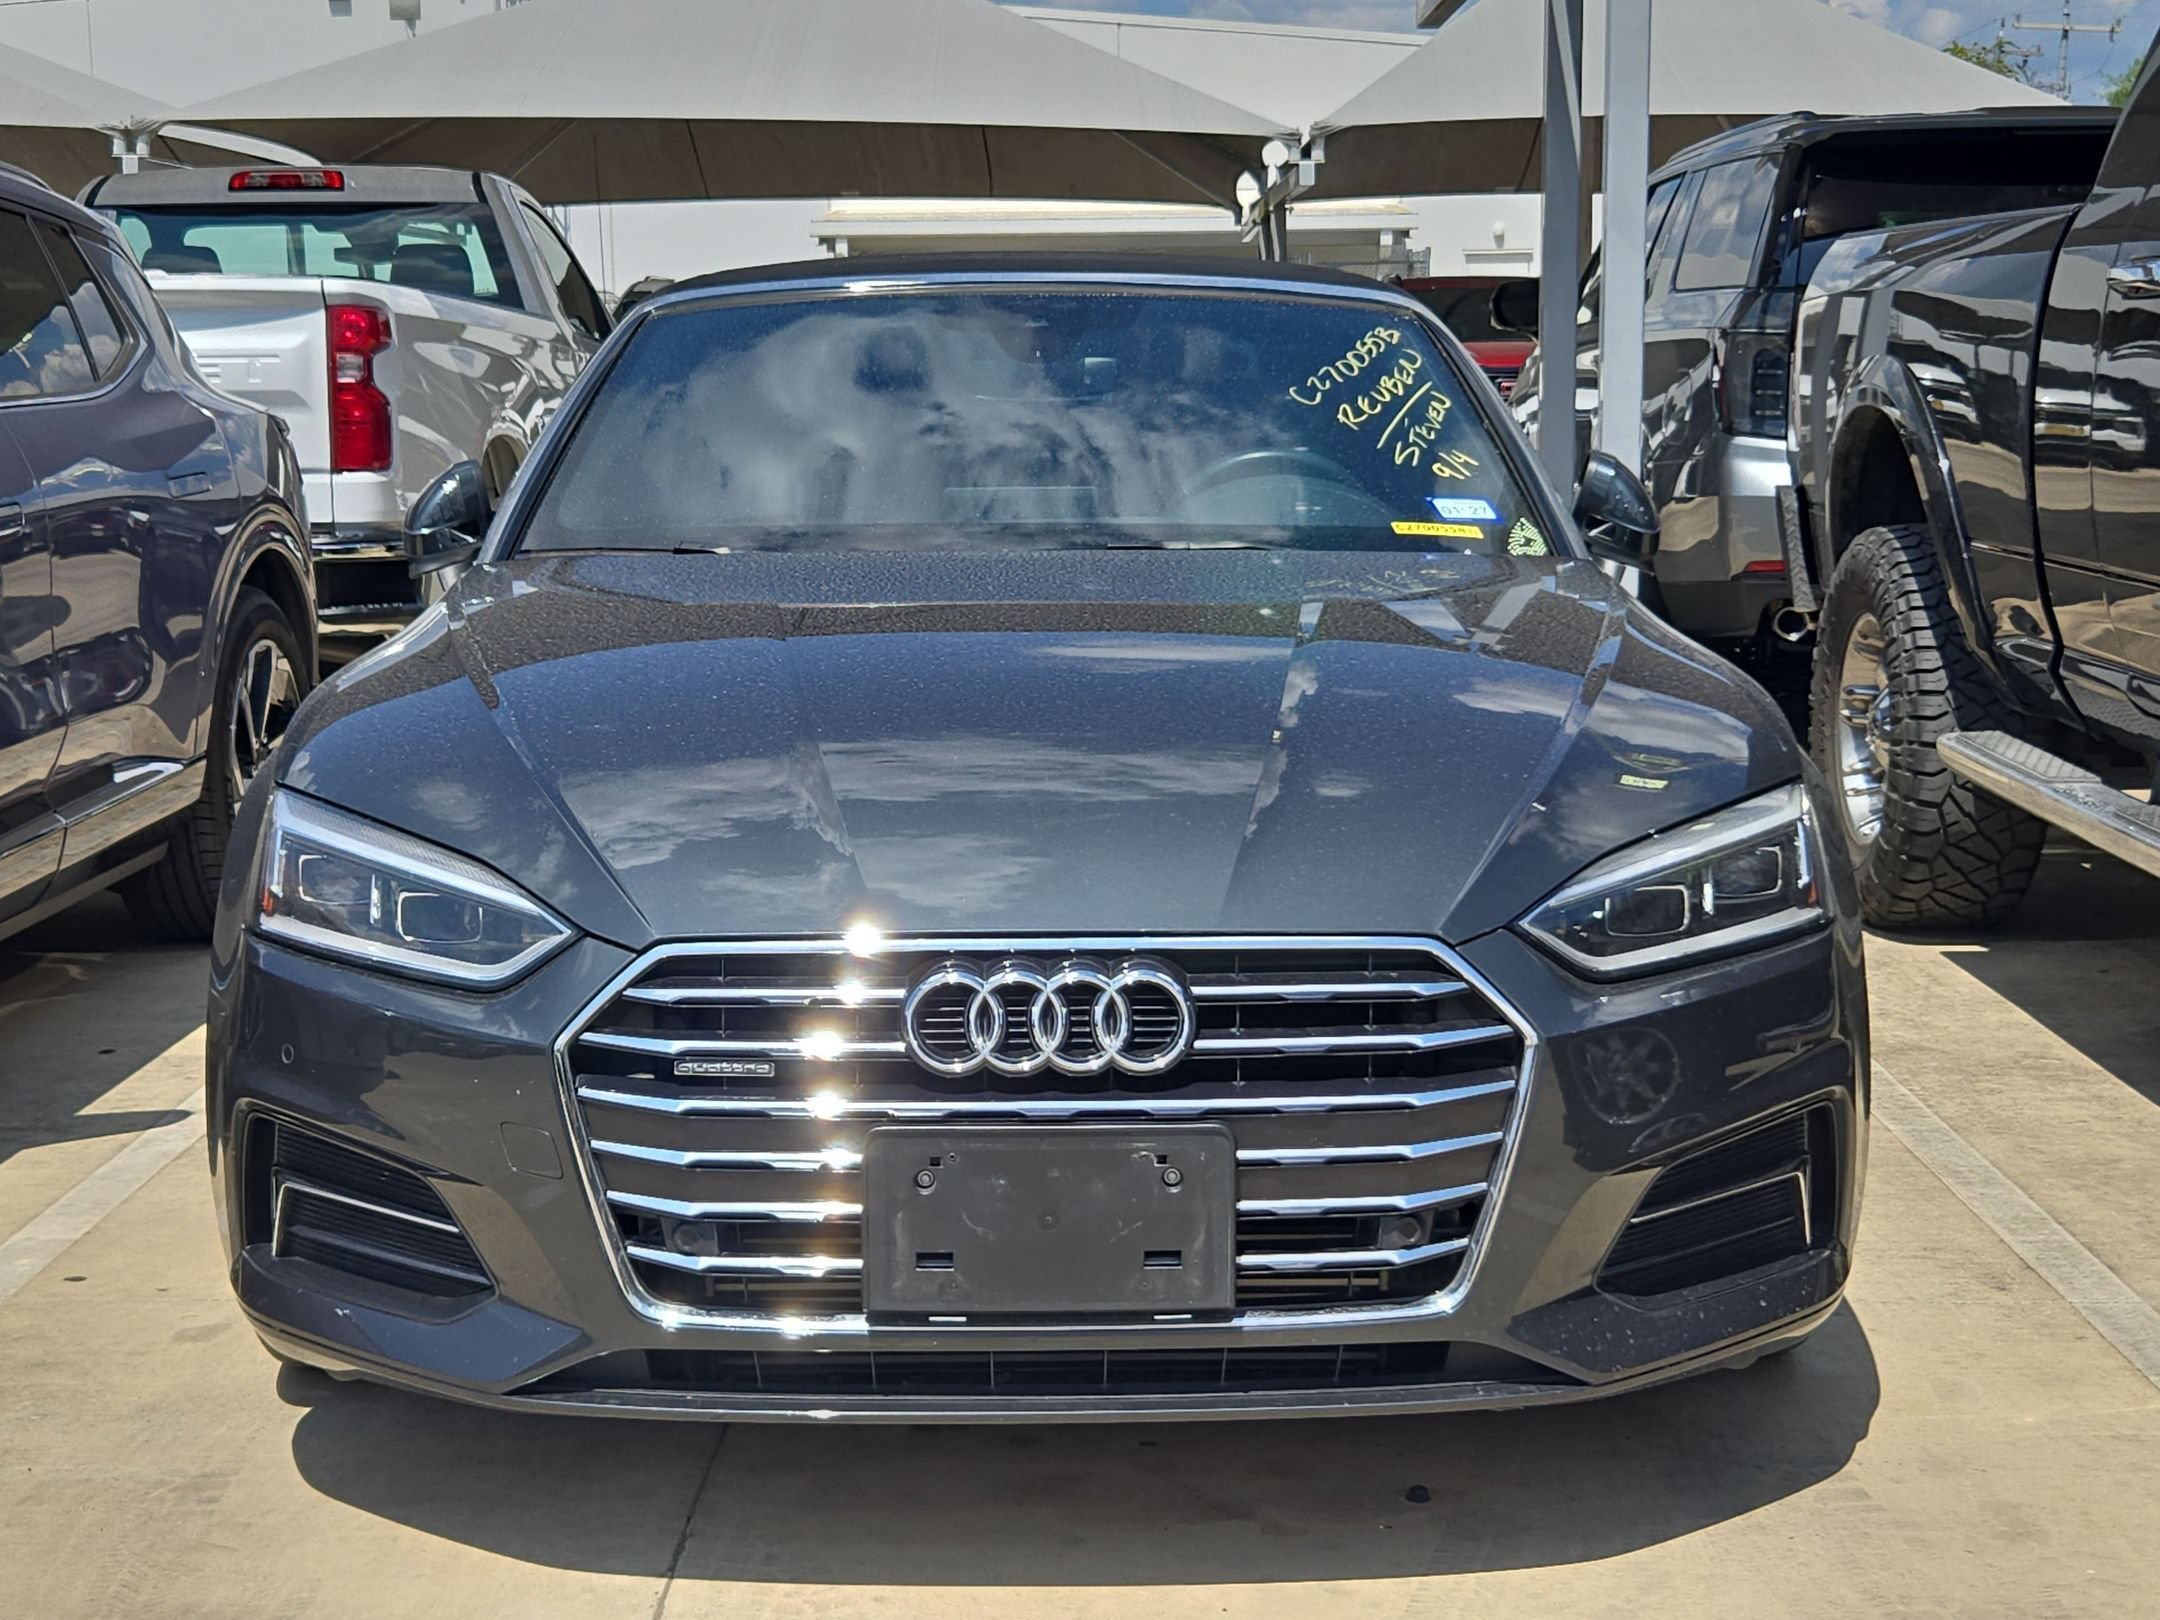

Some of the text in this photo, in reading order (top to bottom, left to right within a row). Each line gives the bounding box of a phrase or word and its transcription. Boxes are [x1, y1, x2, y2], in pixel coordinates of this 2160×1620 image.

[1337, 348, 1421, 430] REUBEN
[1394, 390, 1451, 467] STEVEN
[1431, 449, 1479, 480] 9/4
[678, 1062, 770, 1074] quattro
